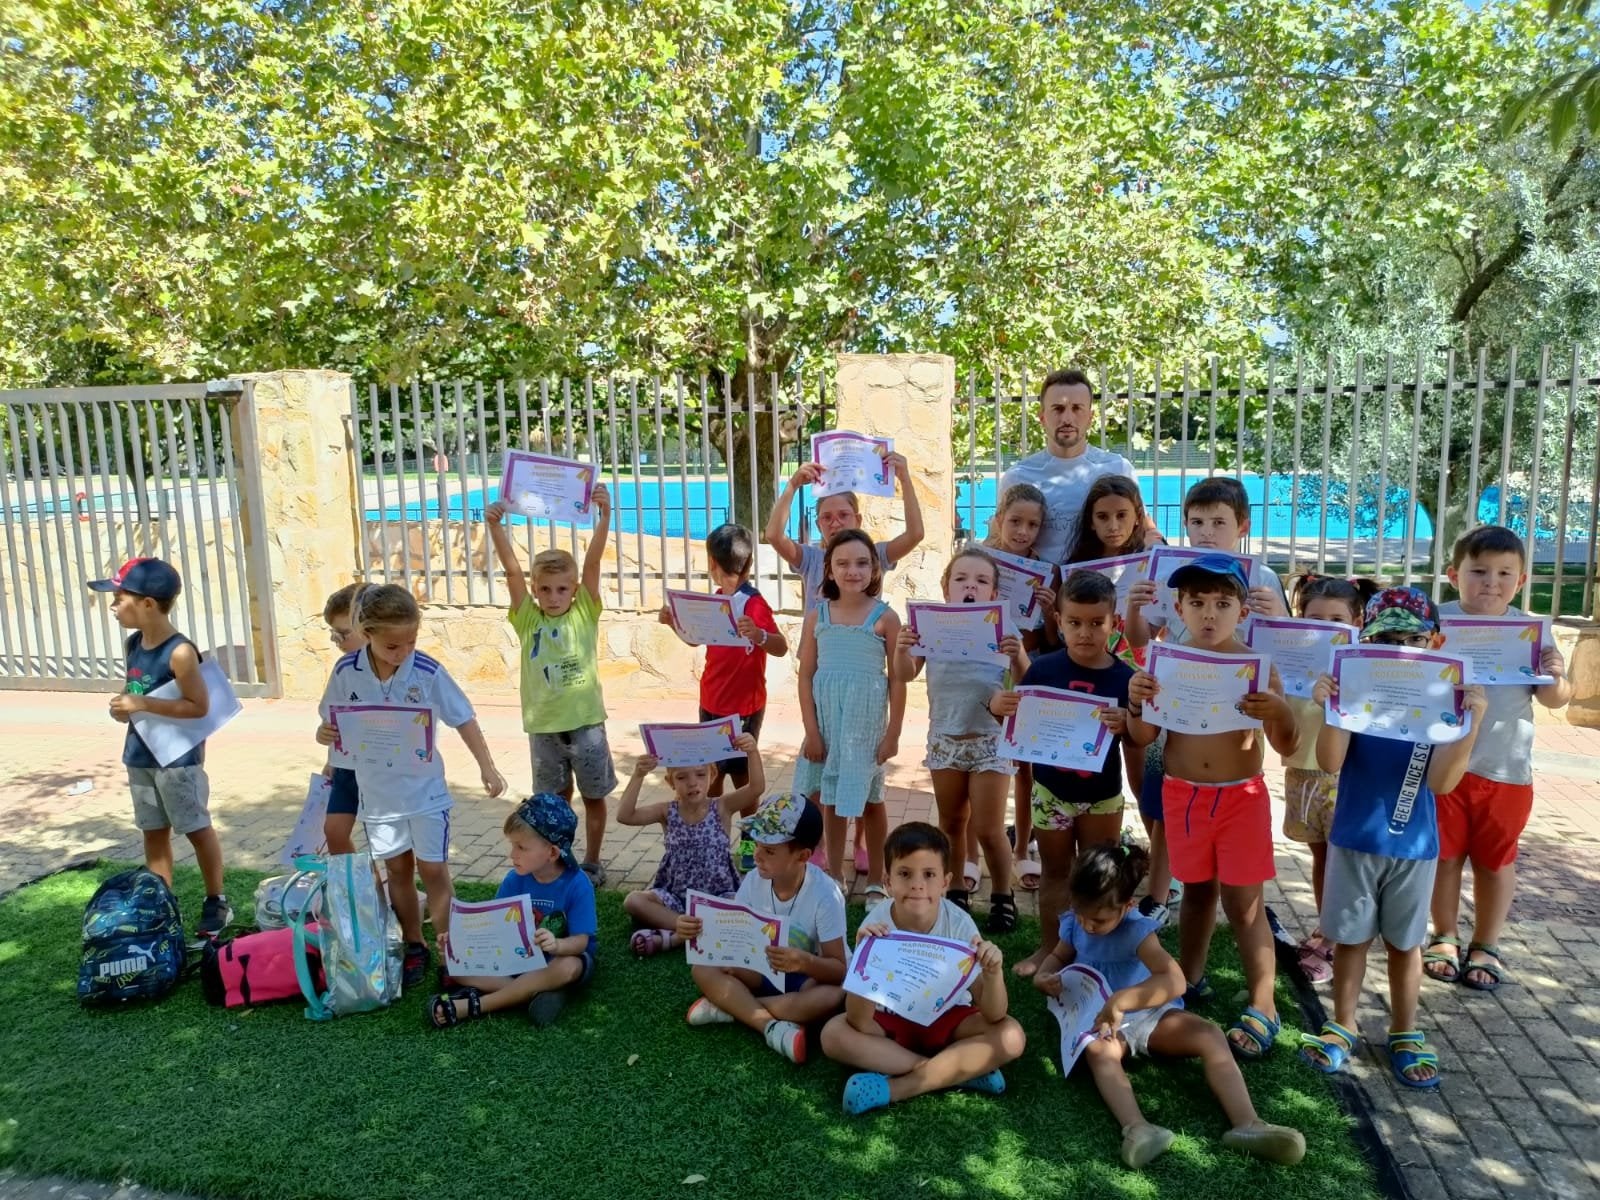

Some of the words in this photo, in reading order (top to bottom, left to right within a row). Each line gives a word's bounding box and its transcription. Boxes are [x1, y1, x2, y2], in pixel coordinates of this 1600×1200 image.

[1412, 752, 1427, 762] IS
[1405, 763, 1424, 788] NICE
[1395, 790, 1415, 821] BEING
[100, 955, 147, 978] PUMA
